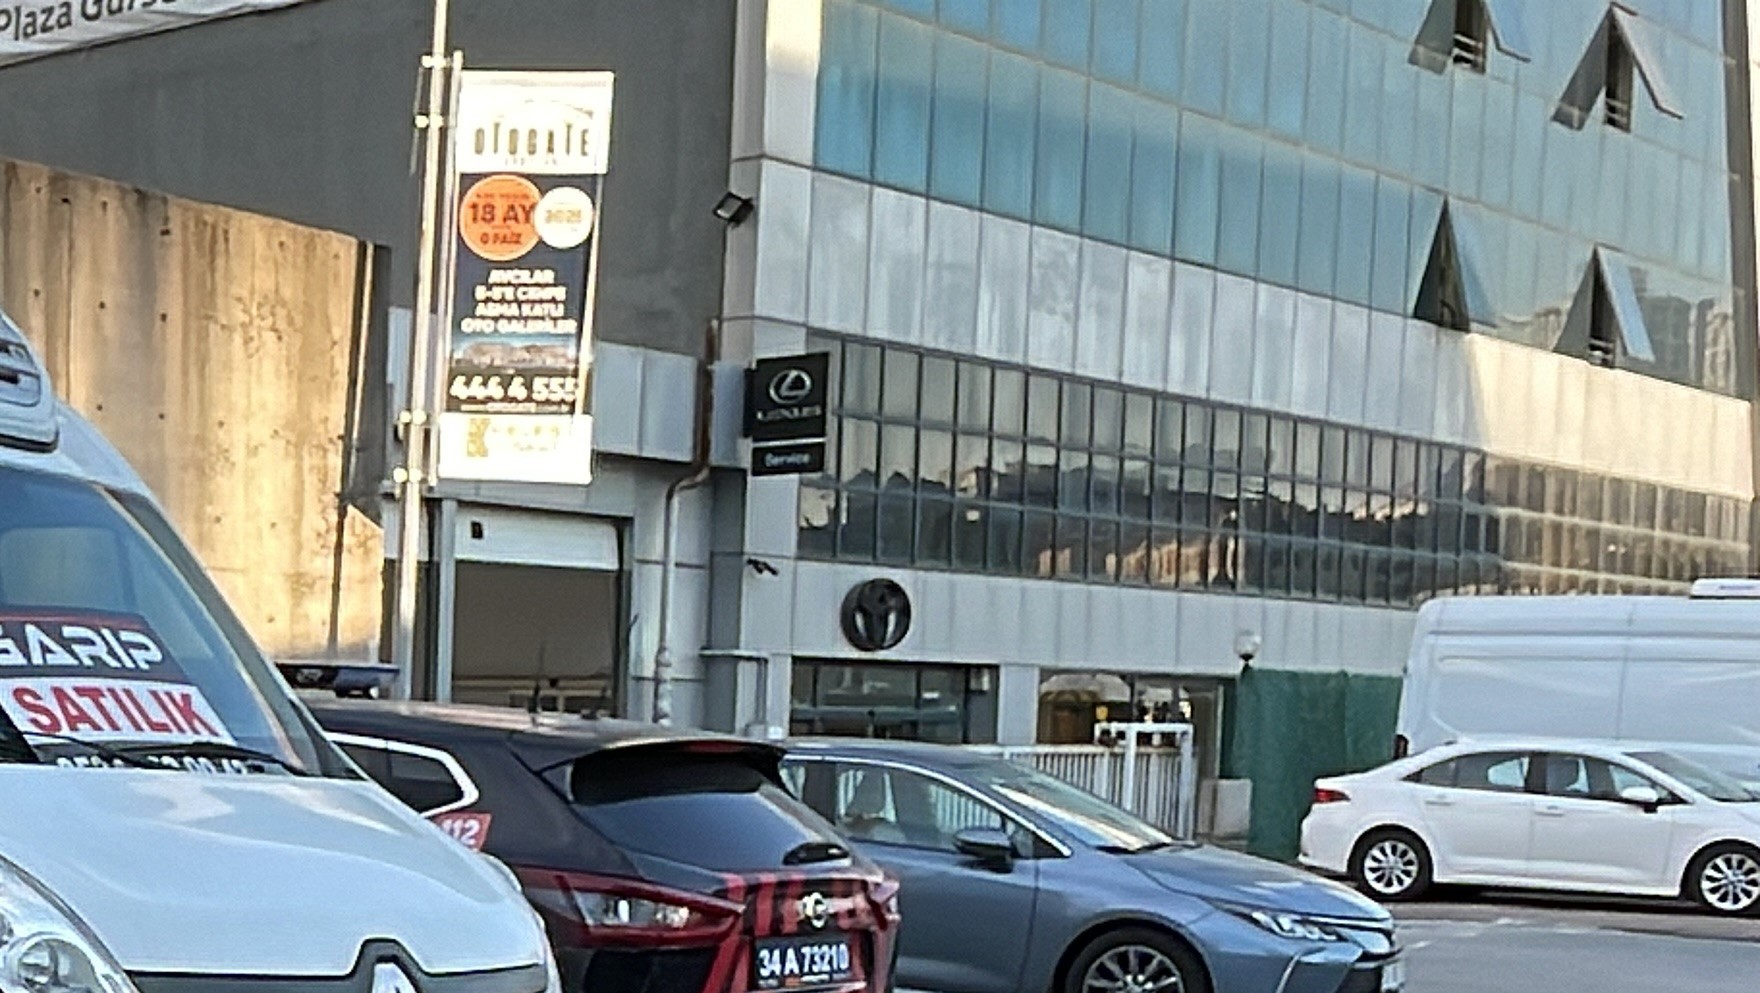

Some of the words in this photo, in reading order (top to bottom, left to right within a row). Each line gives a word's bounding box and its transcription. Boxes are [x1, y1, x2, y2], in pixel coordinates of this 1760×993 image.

[474, 122, 590, 156] OTOGATE
[469, 203, 496, 225] 18
[503, 203, 538, 225] AY
[11, 684, 221, 738] SATILIK
[758, 947, 782, 978] 34
[783, 947, 801, 976] A
[801, 943, 850, 974] 73210
